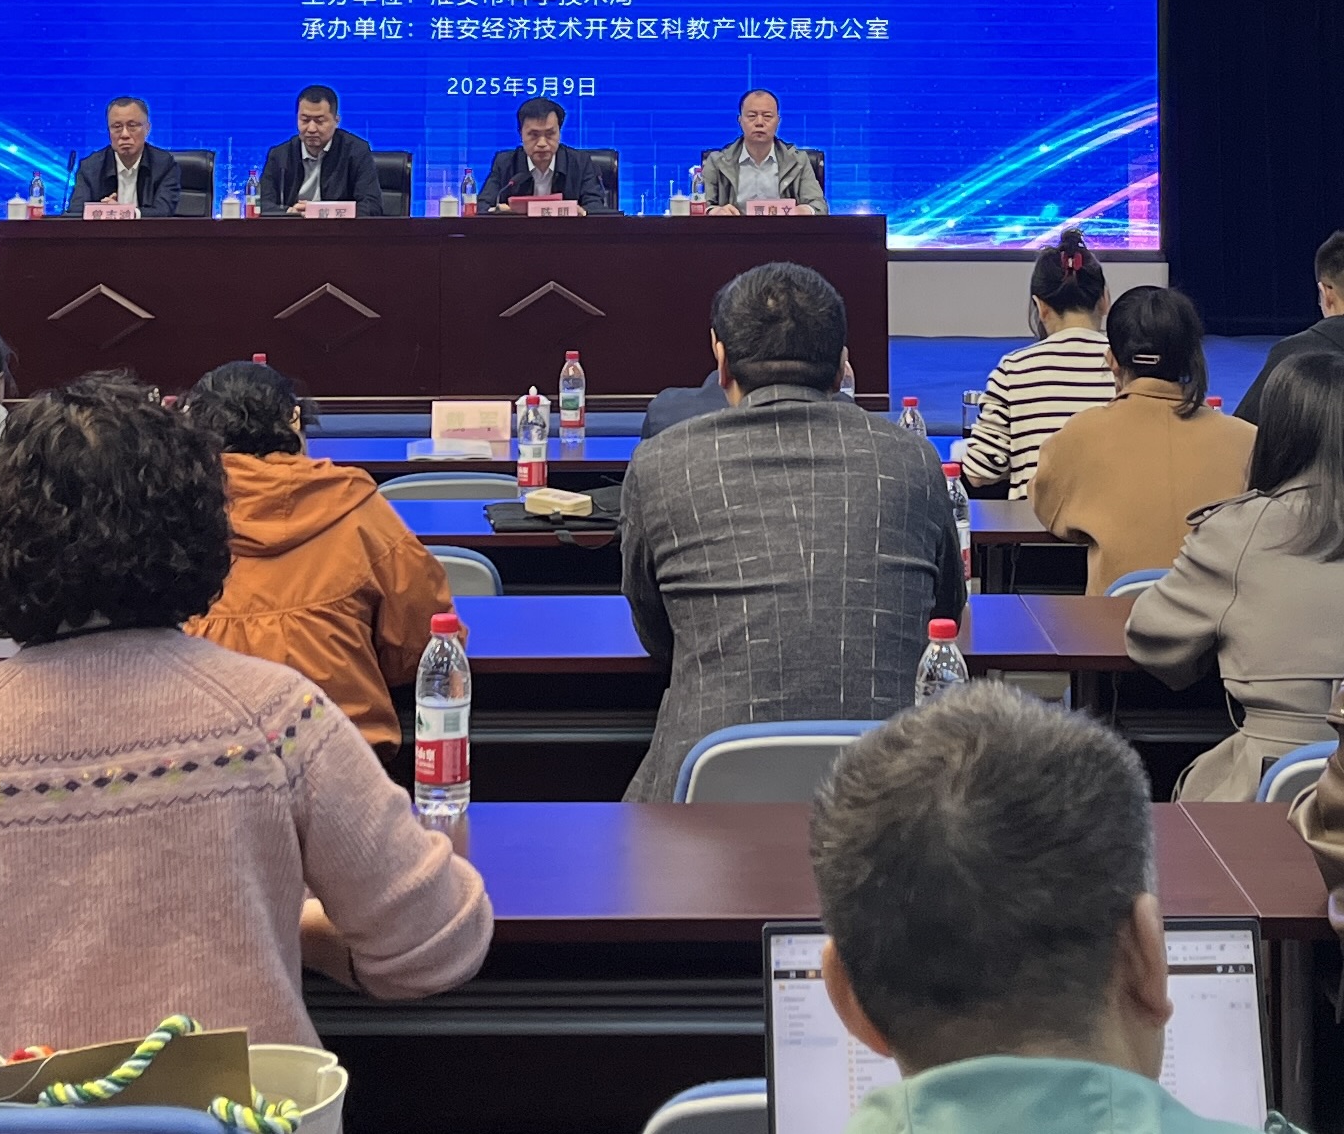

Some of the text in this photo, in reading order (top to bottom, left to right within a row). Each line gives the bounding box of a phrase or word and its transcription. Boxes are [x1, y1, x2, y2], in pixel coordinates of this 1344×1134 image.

[301, 16, 890, 40] 承办单位：淮安经济技术开发区科教产业发展办公室
[447, 76, 596, 97] 2025年5月9日
